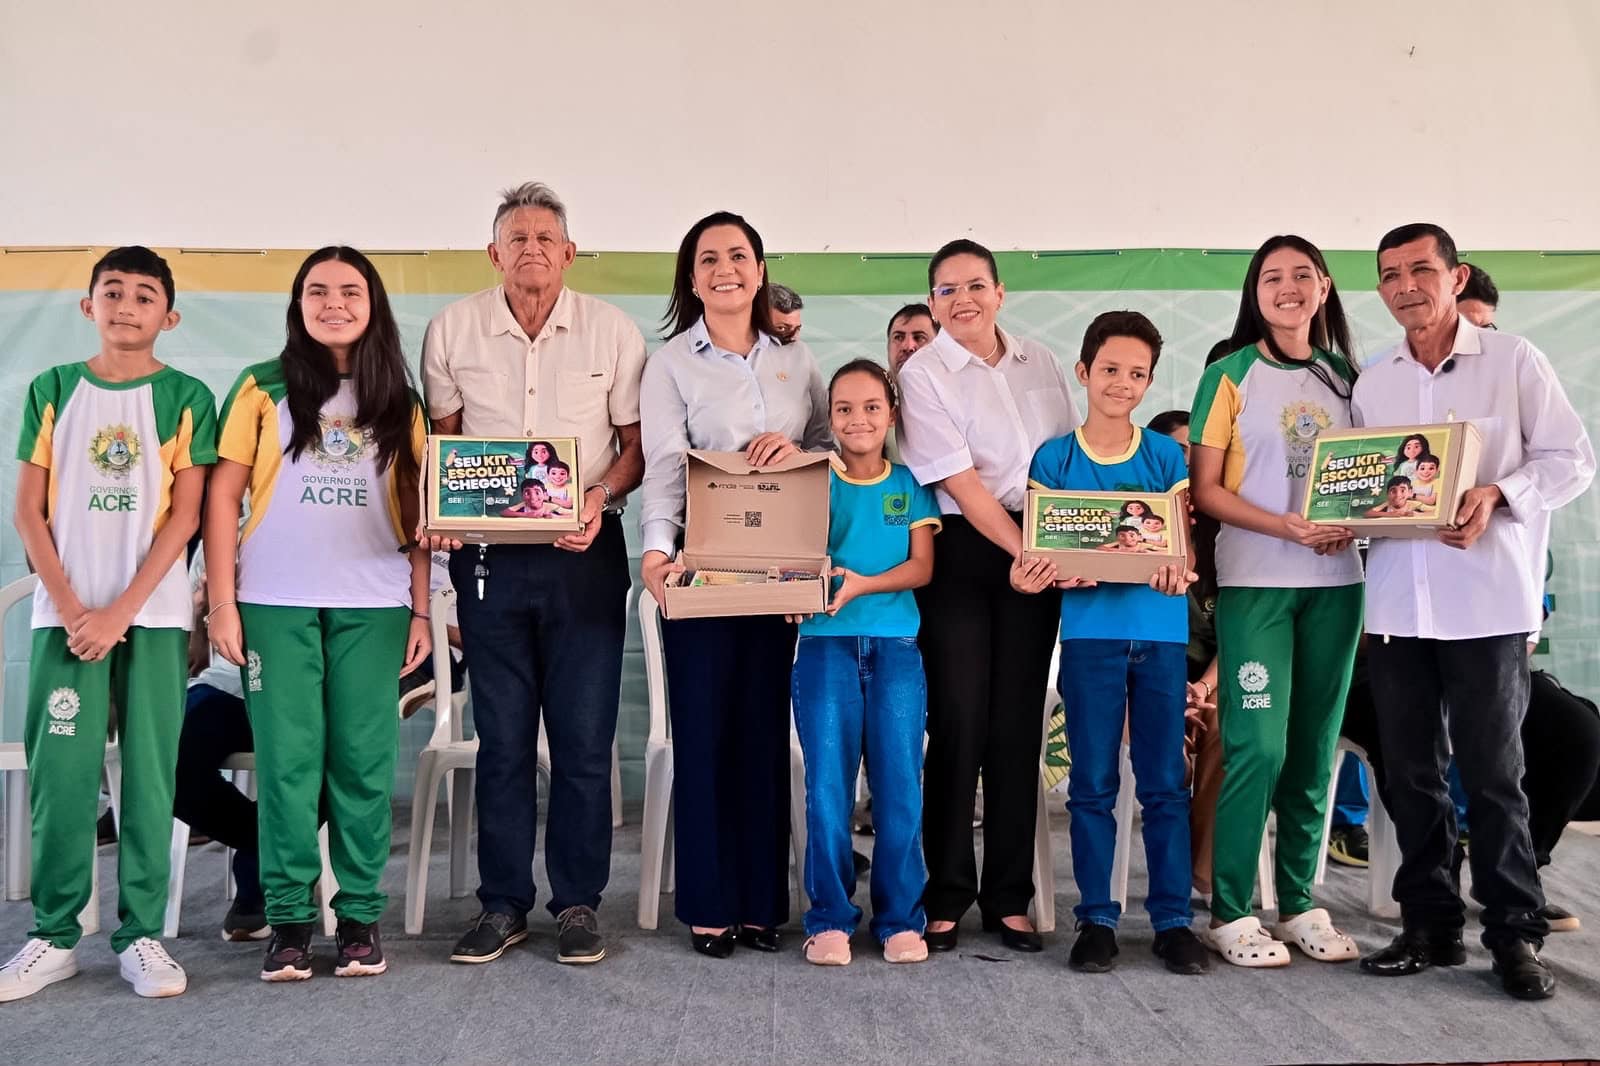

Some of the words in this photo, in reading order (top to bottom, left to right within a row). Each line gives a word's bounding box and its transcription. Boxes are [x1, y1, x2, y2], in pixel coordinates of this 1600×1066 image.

[454, 456, 481, 468] SEU
[484, 455, 509, 466] KIT
[1328, 458, 1354, 471] SEU
[1355, 453, 1380, 467] KIT
[447, 466, 516, 480] ESCOLAR
[1286, 463, 1310, 478] AC
[1321, 464, 1387, 484] ESCOLAR
[302, 475, 351, 486] GOVERNO
[353, 478, 367, 487] DO
[447, 476, 517, 491] CHEGOU!
[1319, 475, 1385, 495] CHEGOU!
[88, 494, 138, 511] ACRE
[300, 486, 368, 507] ACRE
[1051, 508, 1077, 516] SEU
[1080, 508, 1104, 516] KIT
[1045, 516, 1111, 524] ESCOLAR
[1045, 523, 1112, 532] CHEGOU!
[1242, 698, 1271, 709] ACRE
[48, 725, 76, 736] ACRE
